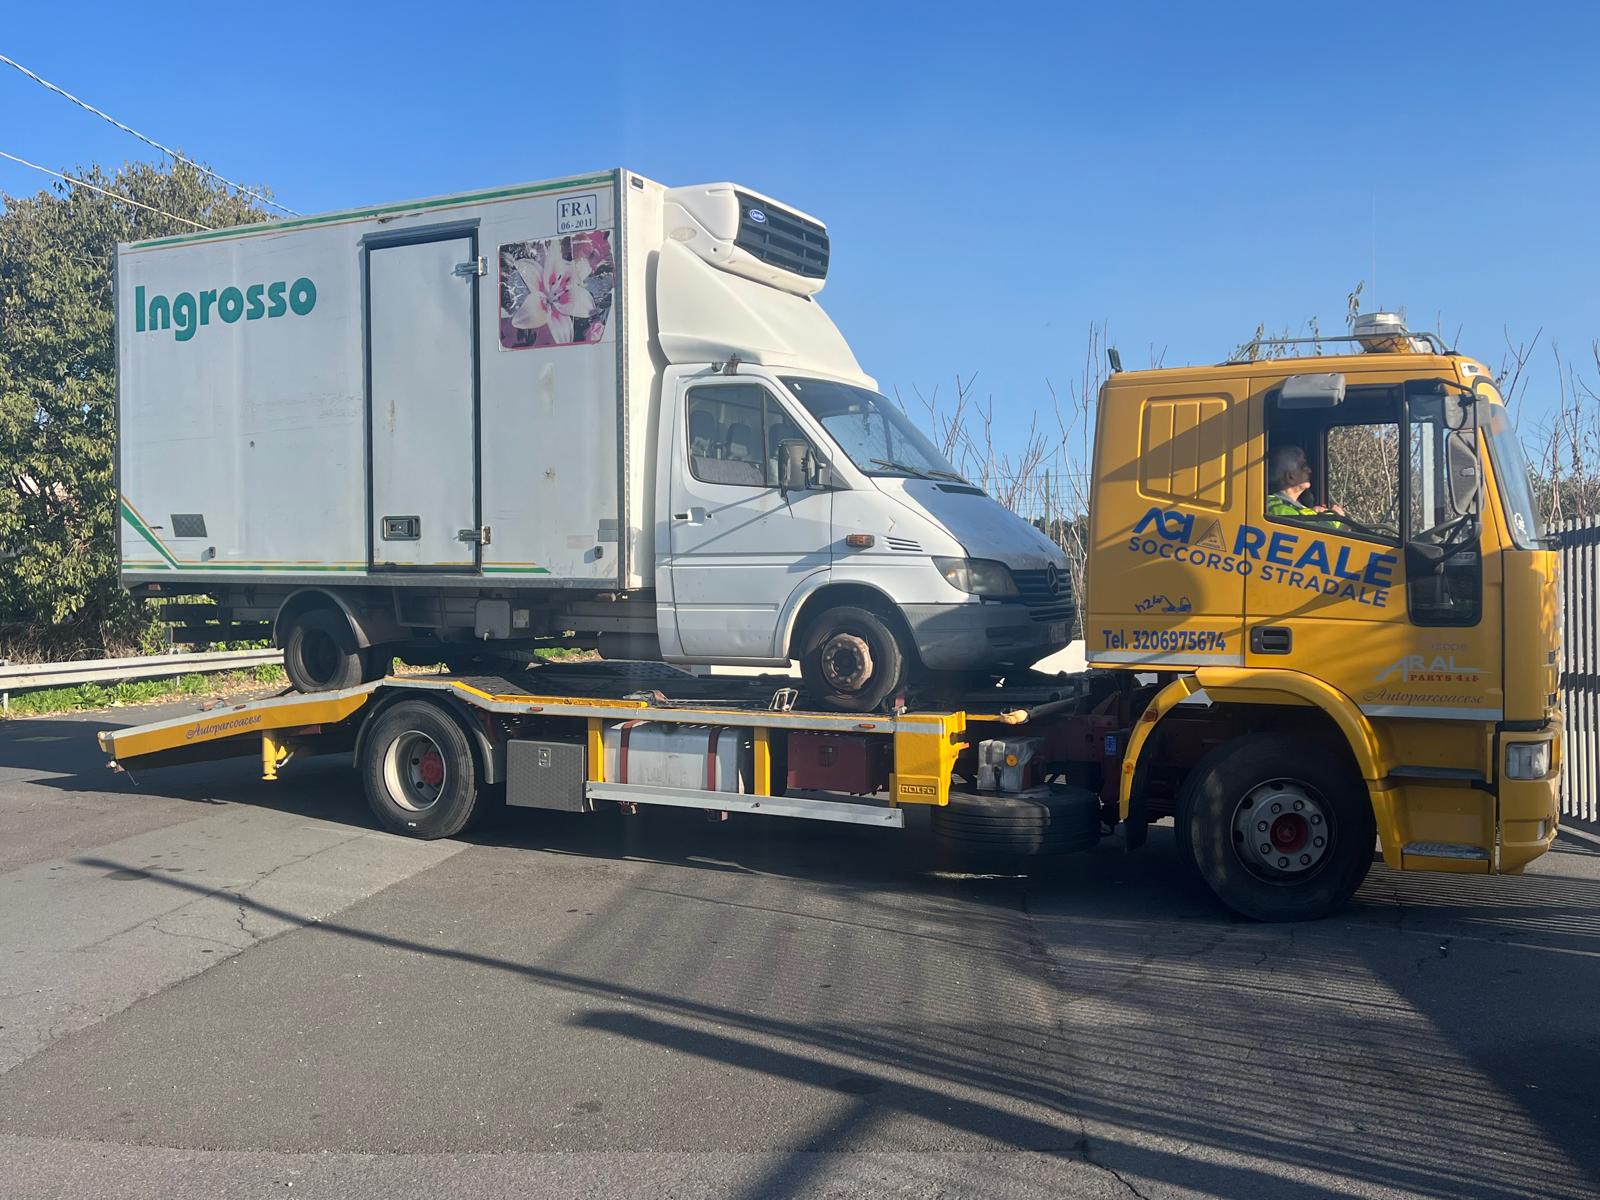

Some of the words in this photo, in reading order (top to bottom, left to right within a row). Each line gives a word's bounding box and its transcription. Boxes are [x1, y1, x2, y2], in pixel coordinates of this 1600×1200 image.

[561, 202, 591, 217] FRA
[561, 218, 592, 230] 06-2011
[135, 277, 317, 342] Ingrosso
[1128, 536, 1253, 576] SOCCORSO
[1260, 565, 1390, 608] STRADALE
[1232, 524, 1398, 588] REALE
[1103, 629, 1128, 649] Tel.
[1133, 630, 1226, 651] 3206975674
